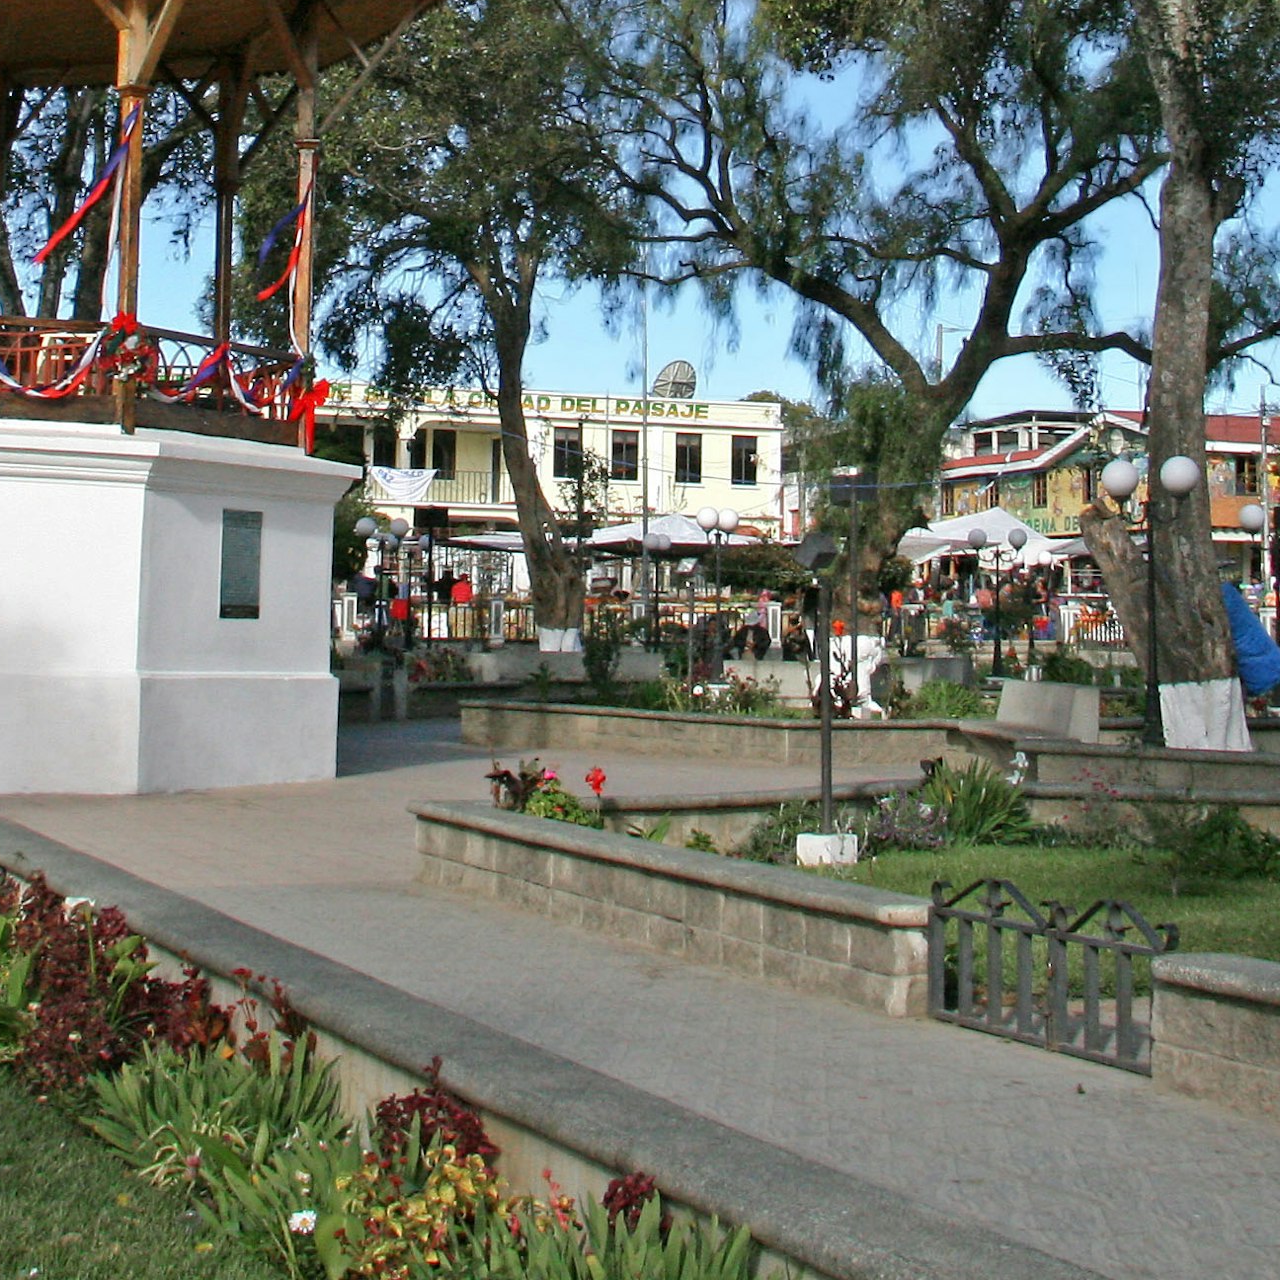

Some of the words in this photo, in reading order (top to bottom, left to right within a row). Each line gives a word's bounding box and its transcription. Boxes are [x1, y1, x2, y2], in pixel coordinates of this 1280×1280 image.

[468, 391, 551, 411] CIAD
[561, 397, 605, 414] DEL
[615, 399, 710, 419] PAISAJE
